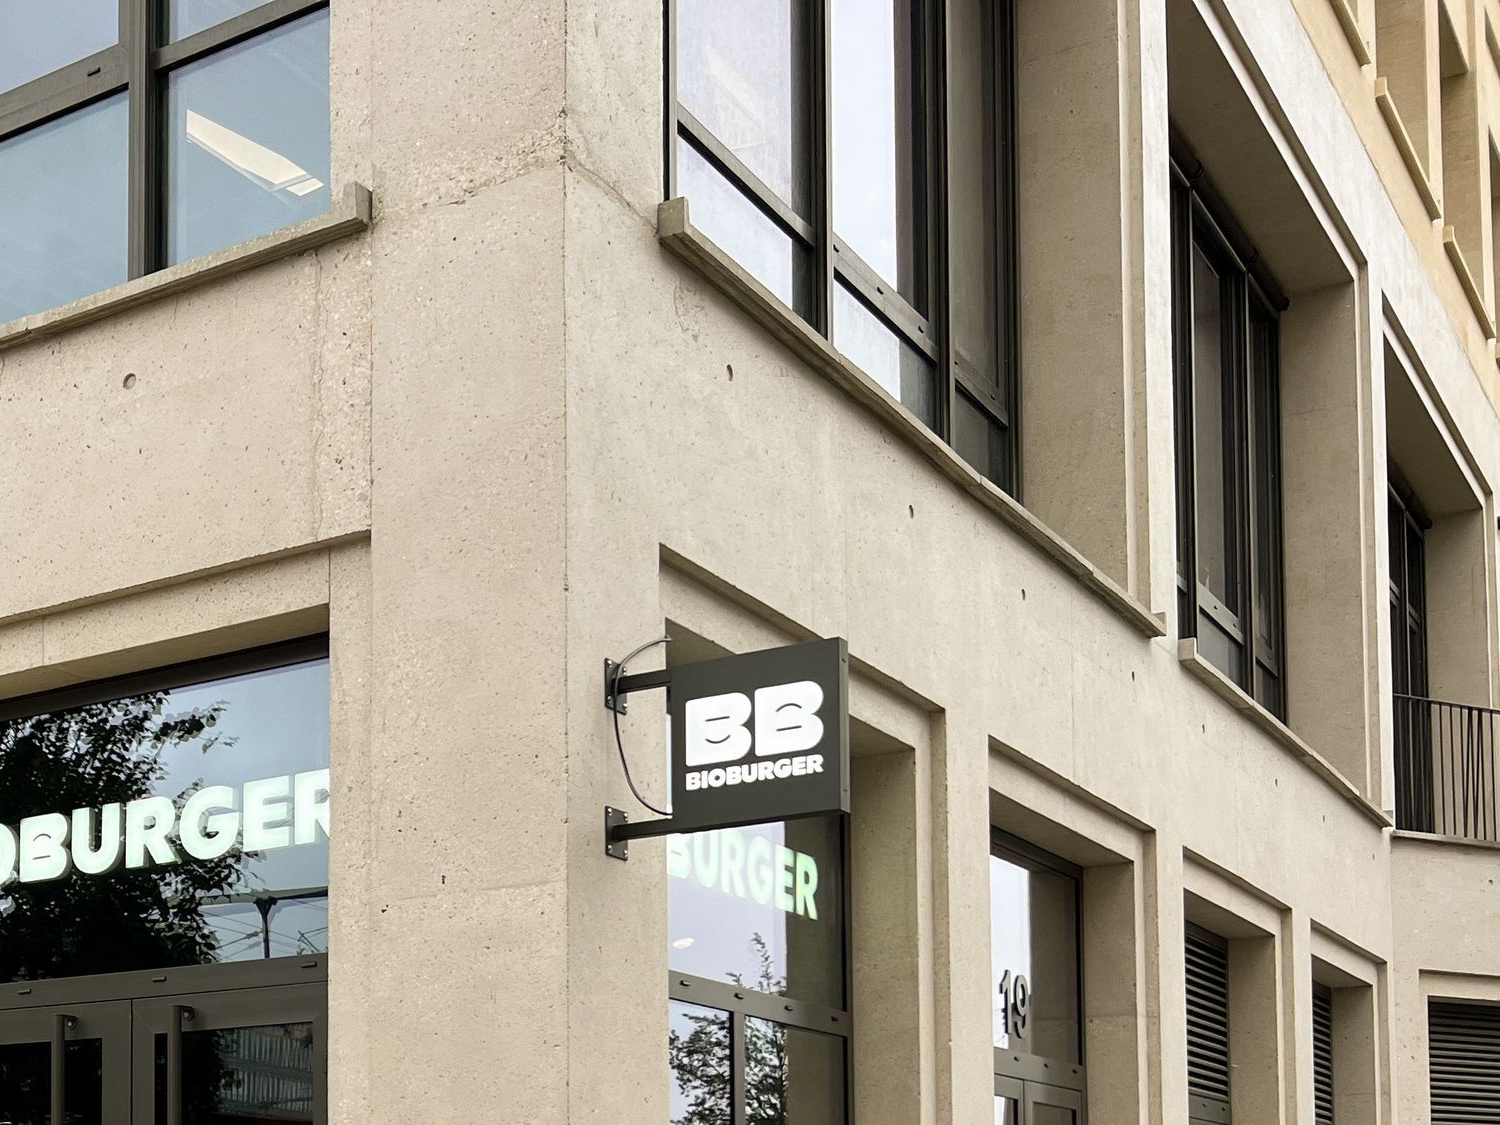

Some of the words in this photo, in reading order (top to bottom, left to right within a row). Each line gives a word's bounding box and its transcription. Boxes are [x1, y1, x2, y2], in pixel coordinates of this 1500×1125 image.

[685, 680, 825, 767] BB
[685, 753, 824, 791] BIOBURGER
[999, 969, 1030, 1040] 19
